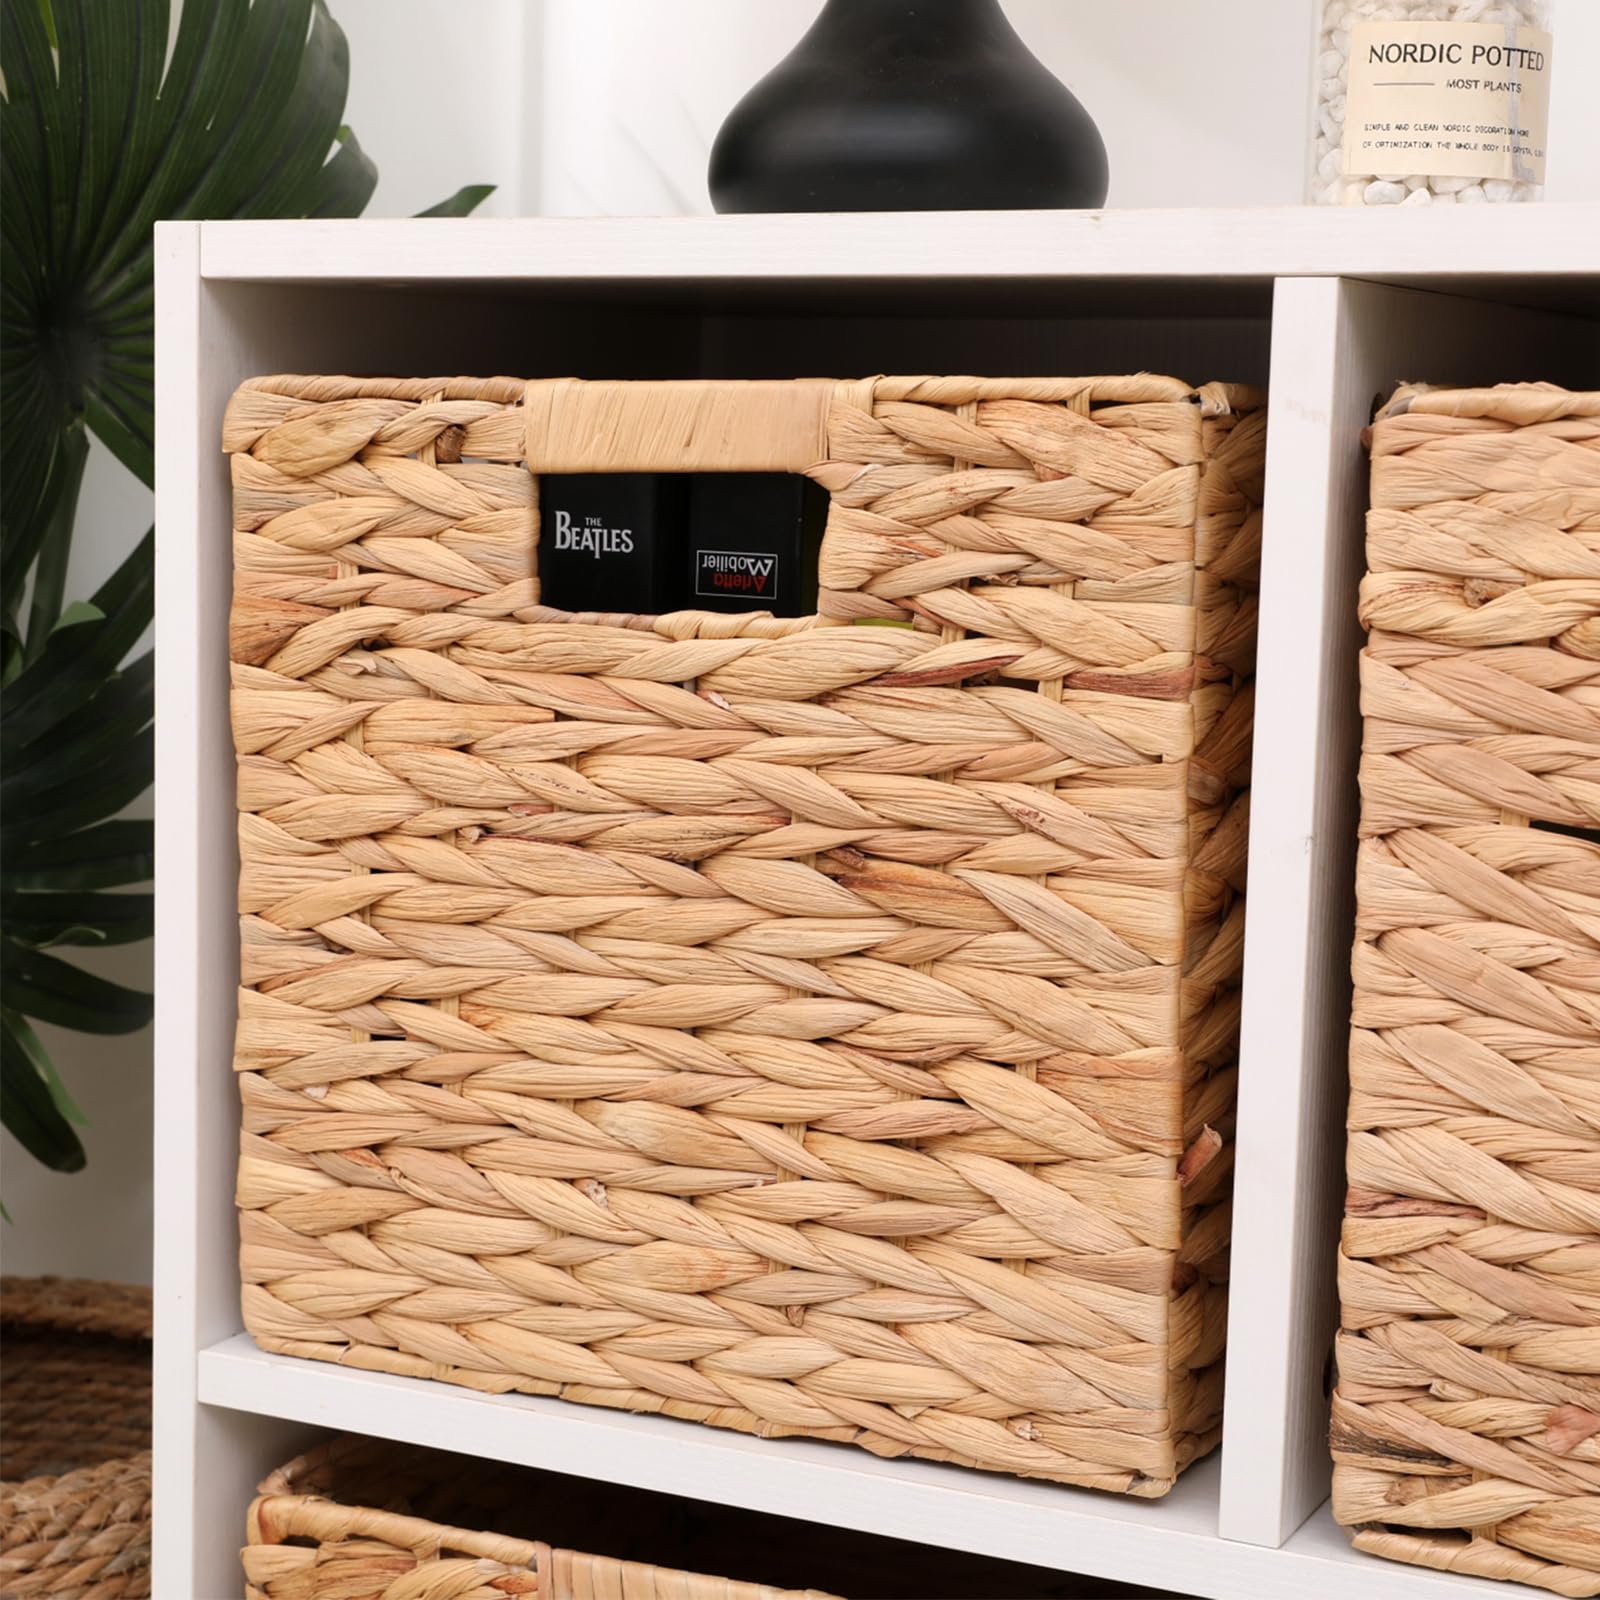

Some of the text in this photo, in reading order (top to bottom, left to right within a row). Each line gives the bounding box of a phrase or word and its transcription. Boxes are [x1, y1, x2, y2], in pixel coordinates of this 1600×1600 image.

[1368, 43, 1545, 72] NORDIC POTTED
[1446, 79, 1522, 94] MOST PLANTS
[1395, 123, 1410, 132] AND
[1413, 123, 1439, 132] CLEAN
[1442, 124, 1472, 133] NORDIC
[1362, 141, 1372, 149] OF
[1375, 141, 1433, 149] OPTIMIZATION
[1436, 141, 1451, 149] THE
[585, 516, 602, 527] THE
[555, 510, 634, 559] BEATLES
[701, 553, 774, 577] Mobilier
